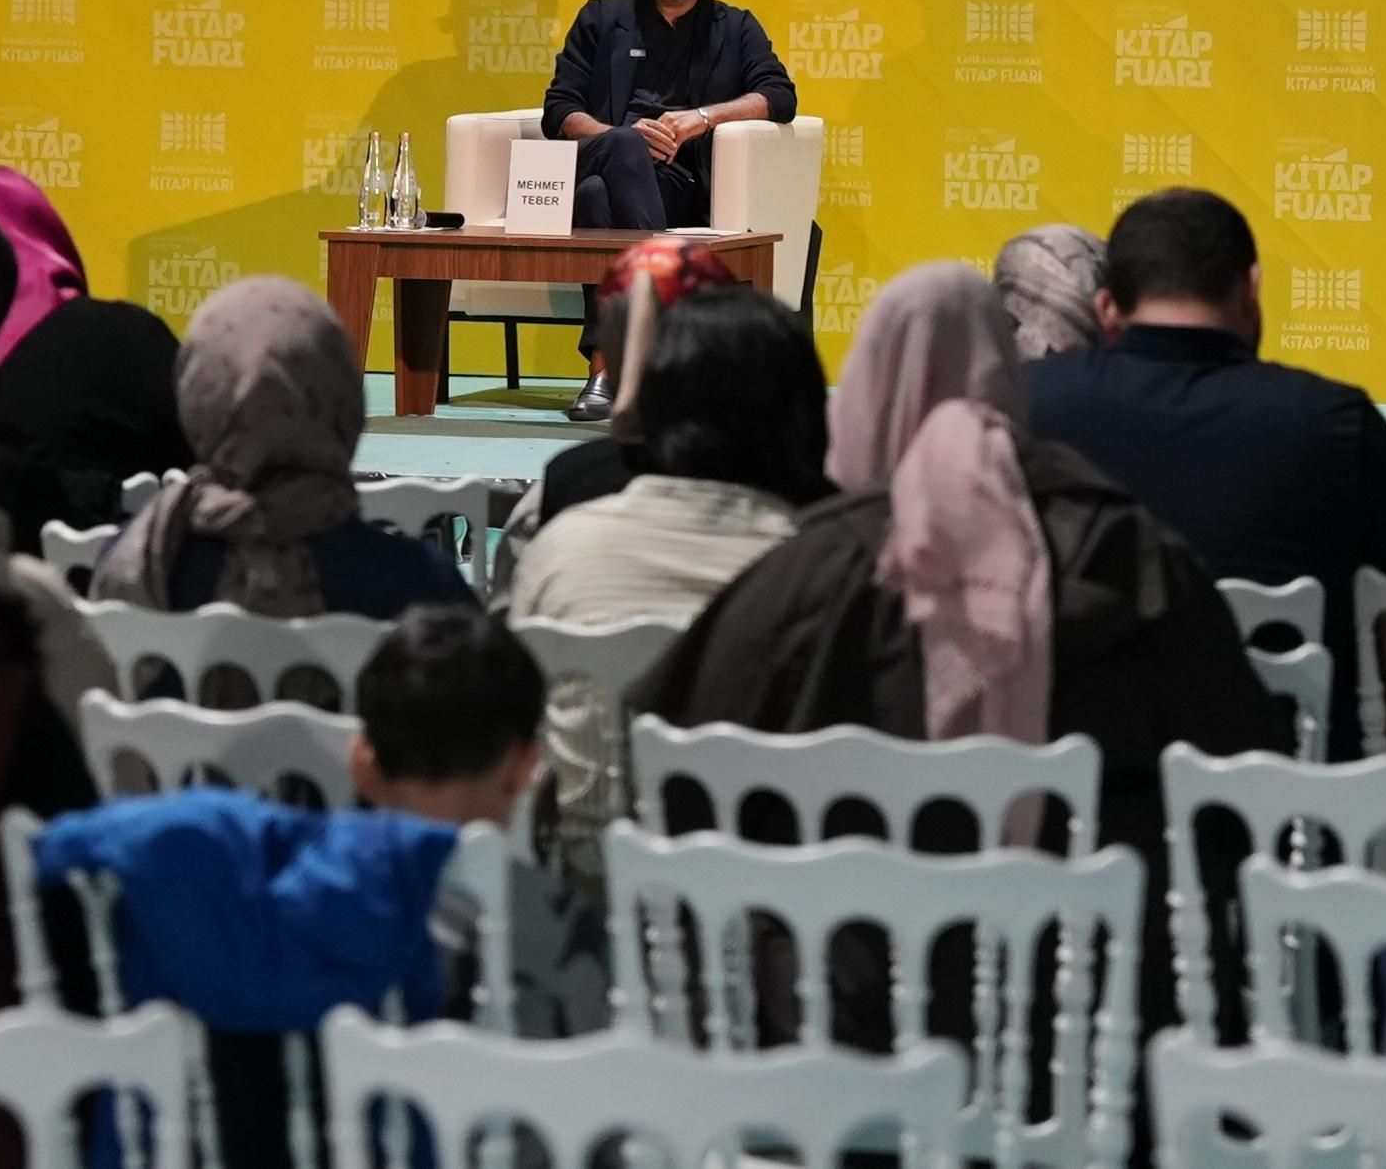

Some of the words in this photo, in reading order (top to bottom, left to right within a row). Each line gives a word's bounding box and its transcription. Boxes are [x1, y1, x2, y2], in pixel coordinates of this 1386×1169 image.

[153, 39, 245, 68] FUARI
[789, 50, 884, 80] FUARI
[1115, 58, 1213, 88] FUARI
[517, 180, 566, 191] MEHMET
[944, 181, 1039, 211] FUARI
[521, 195, 559, 206] TEBER
[1274, 191, 1372, 222] FUARI
[1326, 335, 1370, 351] FUARI
